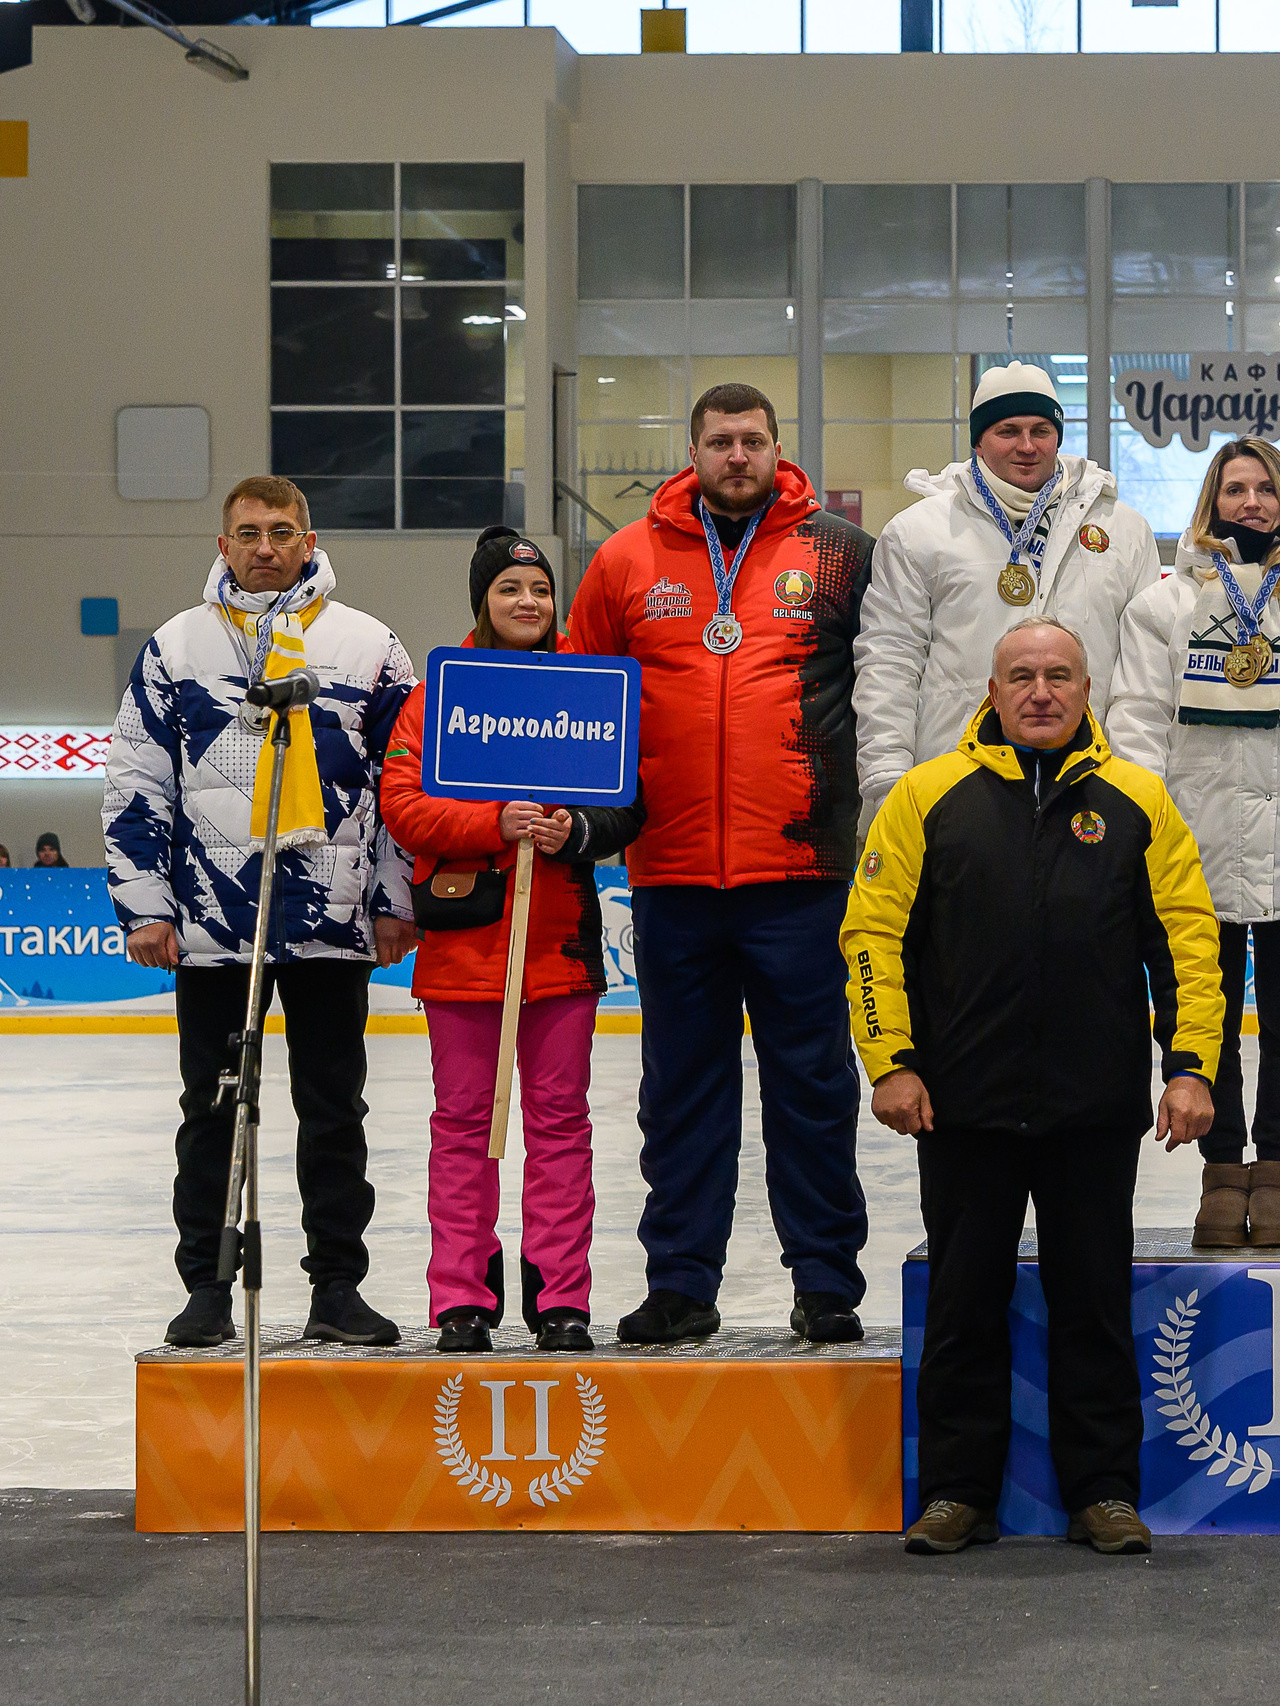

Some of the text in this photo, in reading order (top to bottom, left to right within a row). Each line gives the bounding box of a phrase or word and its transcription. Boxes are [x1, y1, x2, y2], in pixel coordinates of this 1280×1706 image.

[773, 608, 813, 621] BELARUS
[447, 705, 616, 744] Агрохолдинг
[857, 949, 883, 1039] BELARUS
[480, 1381, 560, 1460] II
